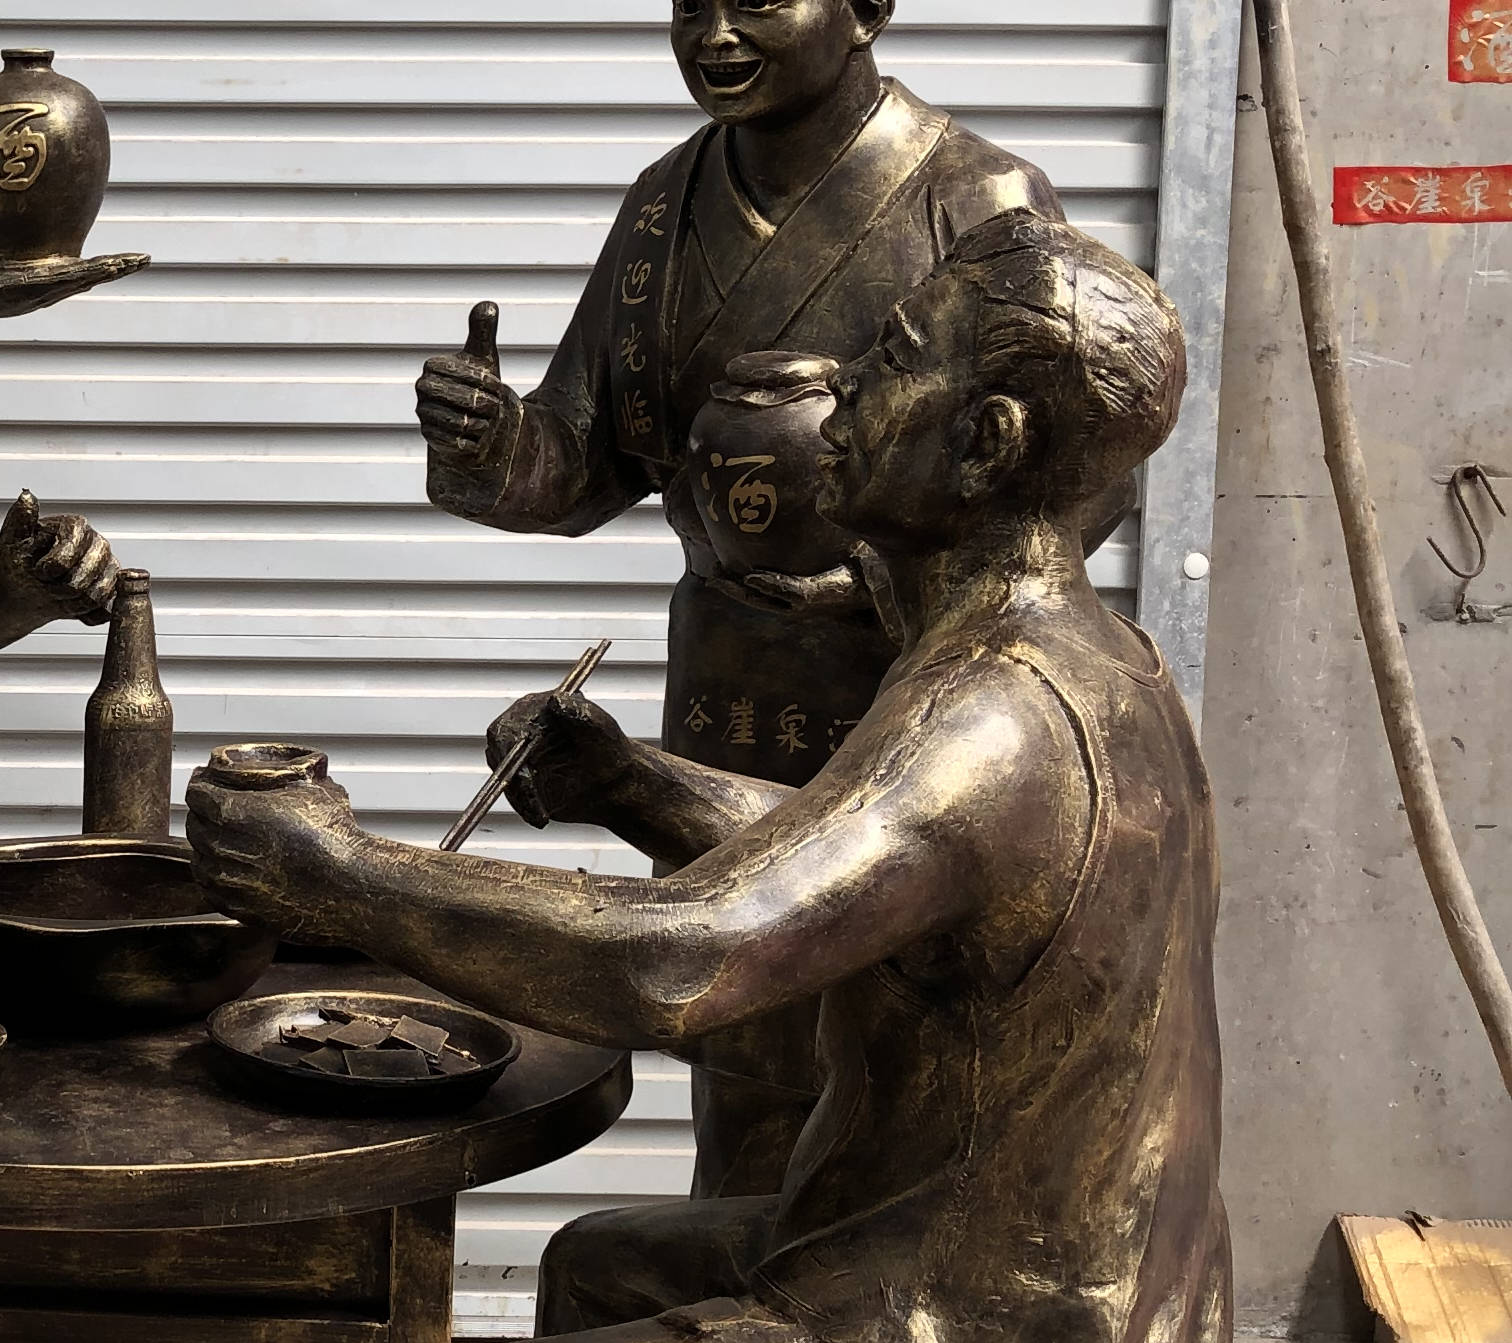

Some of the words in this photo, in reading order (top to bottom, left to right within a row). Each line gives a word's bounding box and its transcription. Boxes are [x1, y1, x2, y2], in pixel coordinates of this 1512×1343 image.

[1354, 170, 1512, 216] 谷崖泉
[620, 191, 667, 437] 欢迎光临
[701, 452, 777, 533] 酒
